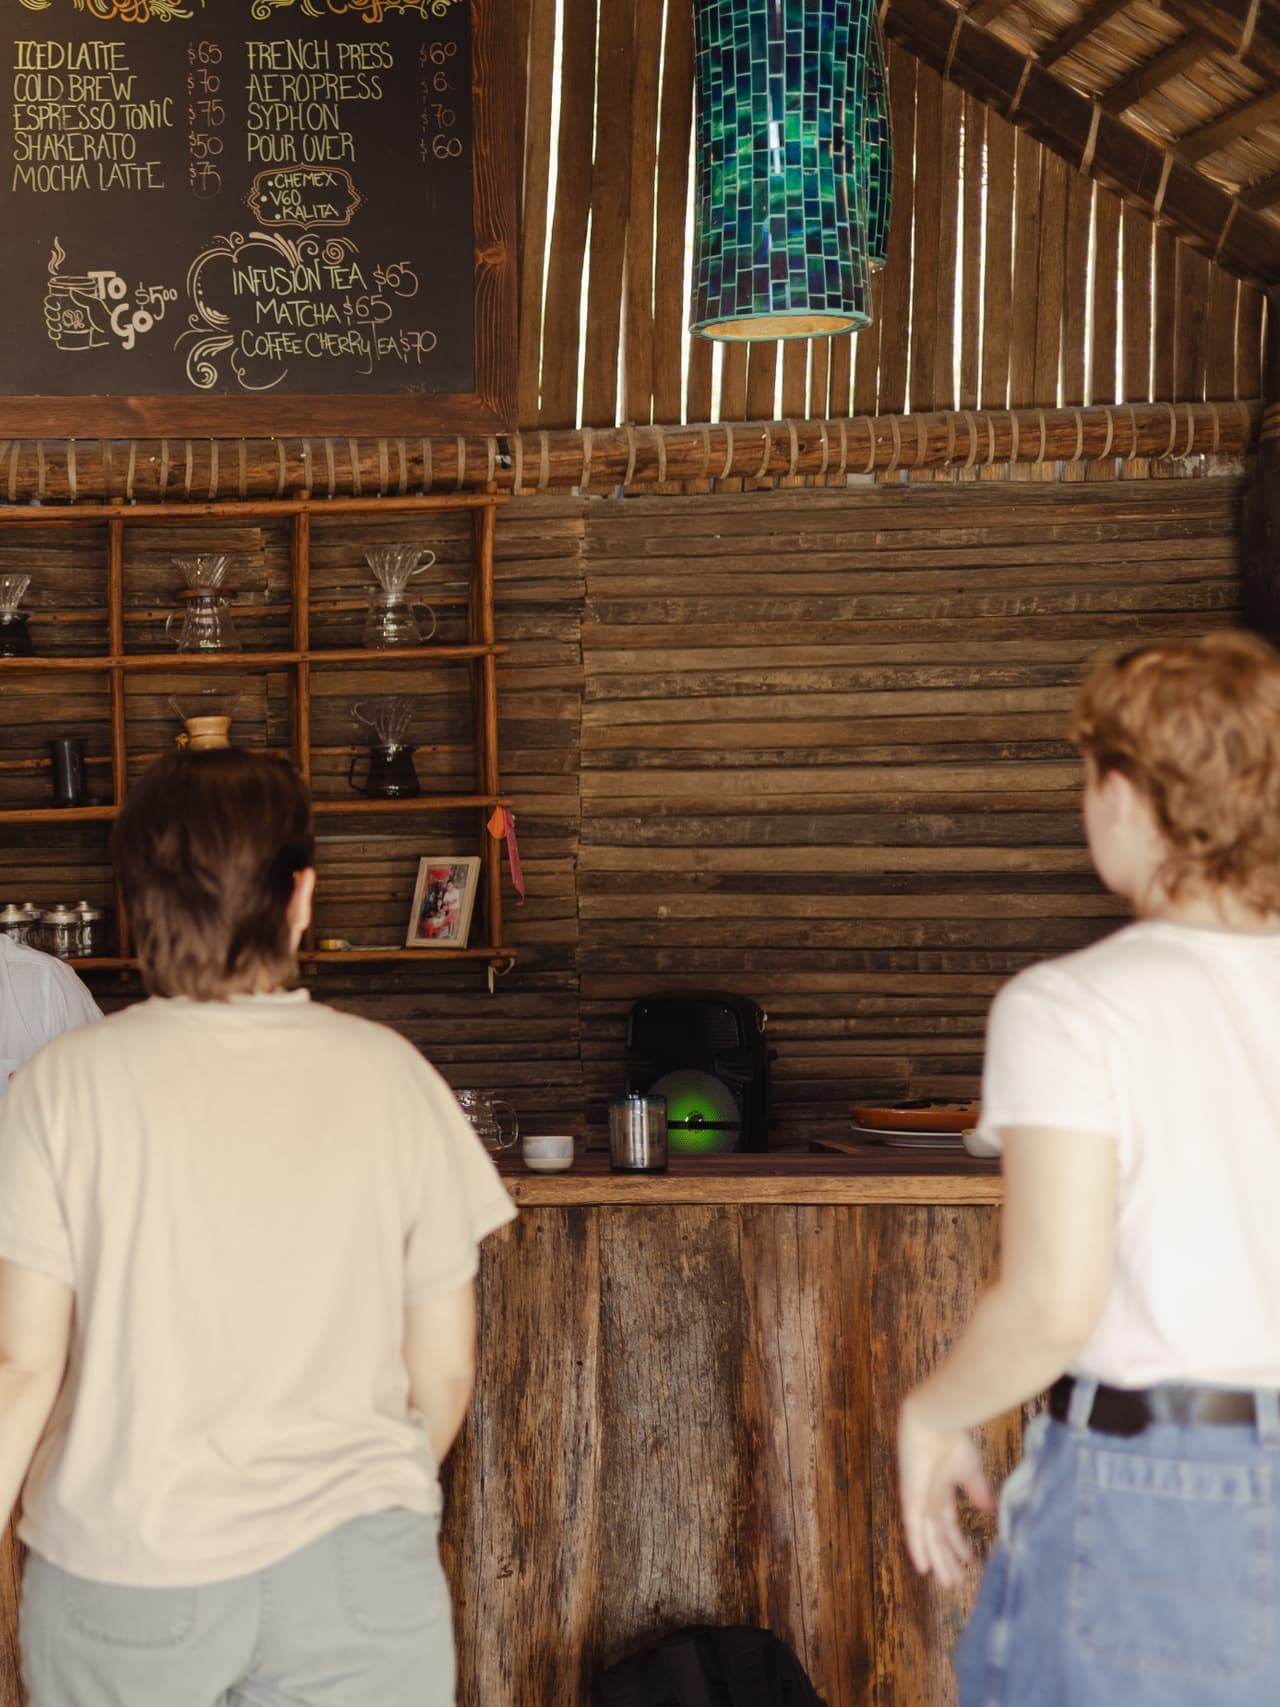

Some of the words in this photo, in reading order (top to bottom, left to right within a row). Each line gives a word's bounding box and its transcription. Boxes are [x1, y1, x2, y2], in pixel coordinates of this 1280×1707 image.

[13, 41, 65, 71] ICED
[67, 40, 130, 71] LATTE
[188, 41, 223, 65] $65
[244, 38, 330, 71] FRENCH
[335, 41, 394, 71] PRESS
[419, 41, 458, 69] $60
[13, 73, 65, 102] COLD
[68, 72, 138, 102] BREW
[187, 69, 220, 96] $70
[245, 72, 384, 102] AEROPRESS
[12, 102, 116, 131] ESPRESSO
[119, 97, 174, 130] TONIC
[188, 99, 226, 128] $75
[247, 102, 340, 131] SYPHON
[421, 104, 457, 133] $70
[13, 131, 137, 161] SHAKERATO
[188, 128, 224, 159] $50
[247, 132, 297, 162] POUR
[302, 131, 356, 162] OVER
[420, 134, 463, 163] $60
[12, 162, 91, 192] MOCHA
[97, 161, 165, 191] LATTE
[188, 161, 222, 200] $75
[273, 172, 338, 189] CHEMEX
[282, 204, 340, 221] KALITA
[232, 258, 322, 297] INFUSION
[323, 262, 368, 291] TEA
[372, 261, 419, 298] $65
[255, 298, 343, 328] MATCHA
[342, 294, 393, 327] $65
[241, 329, 304, 361] COFFEE
[304, 330, 375, 375] CHERRY
[357, 321, 403, 361] TEA
[400, 328, 438, 364] $70
